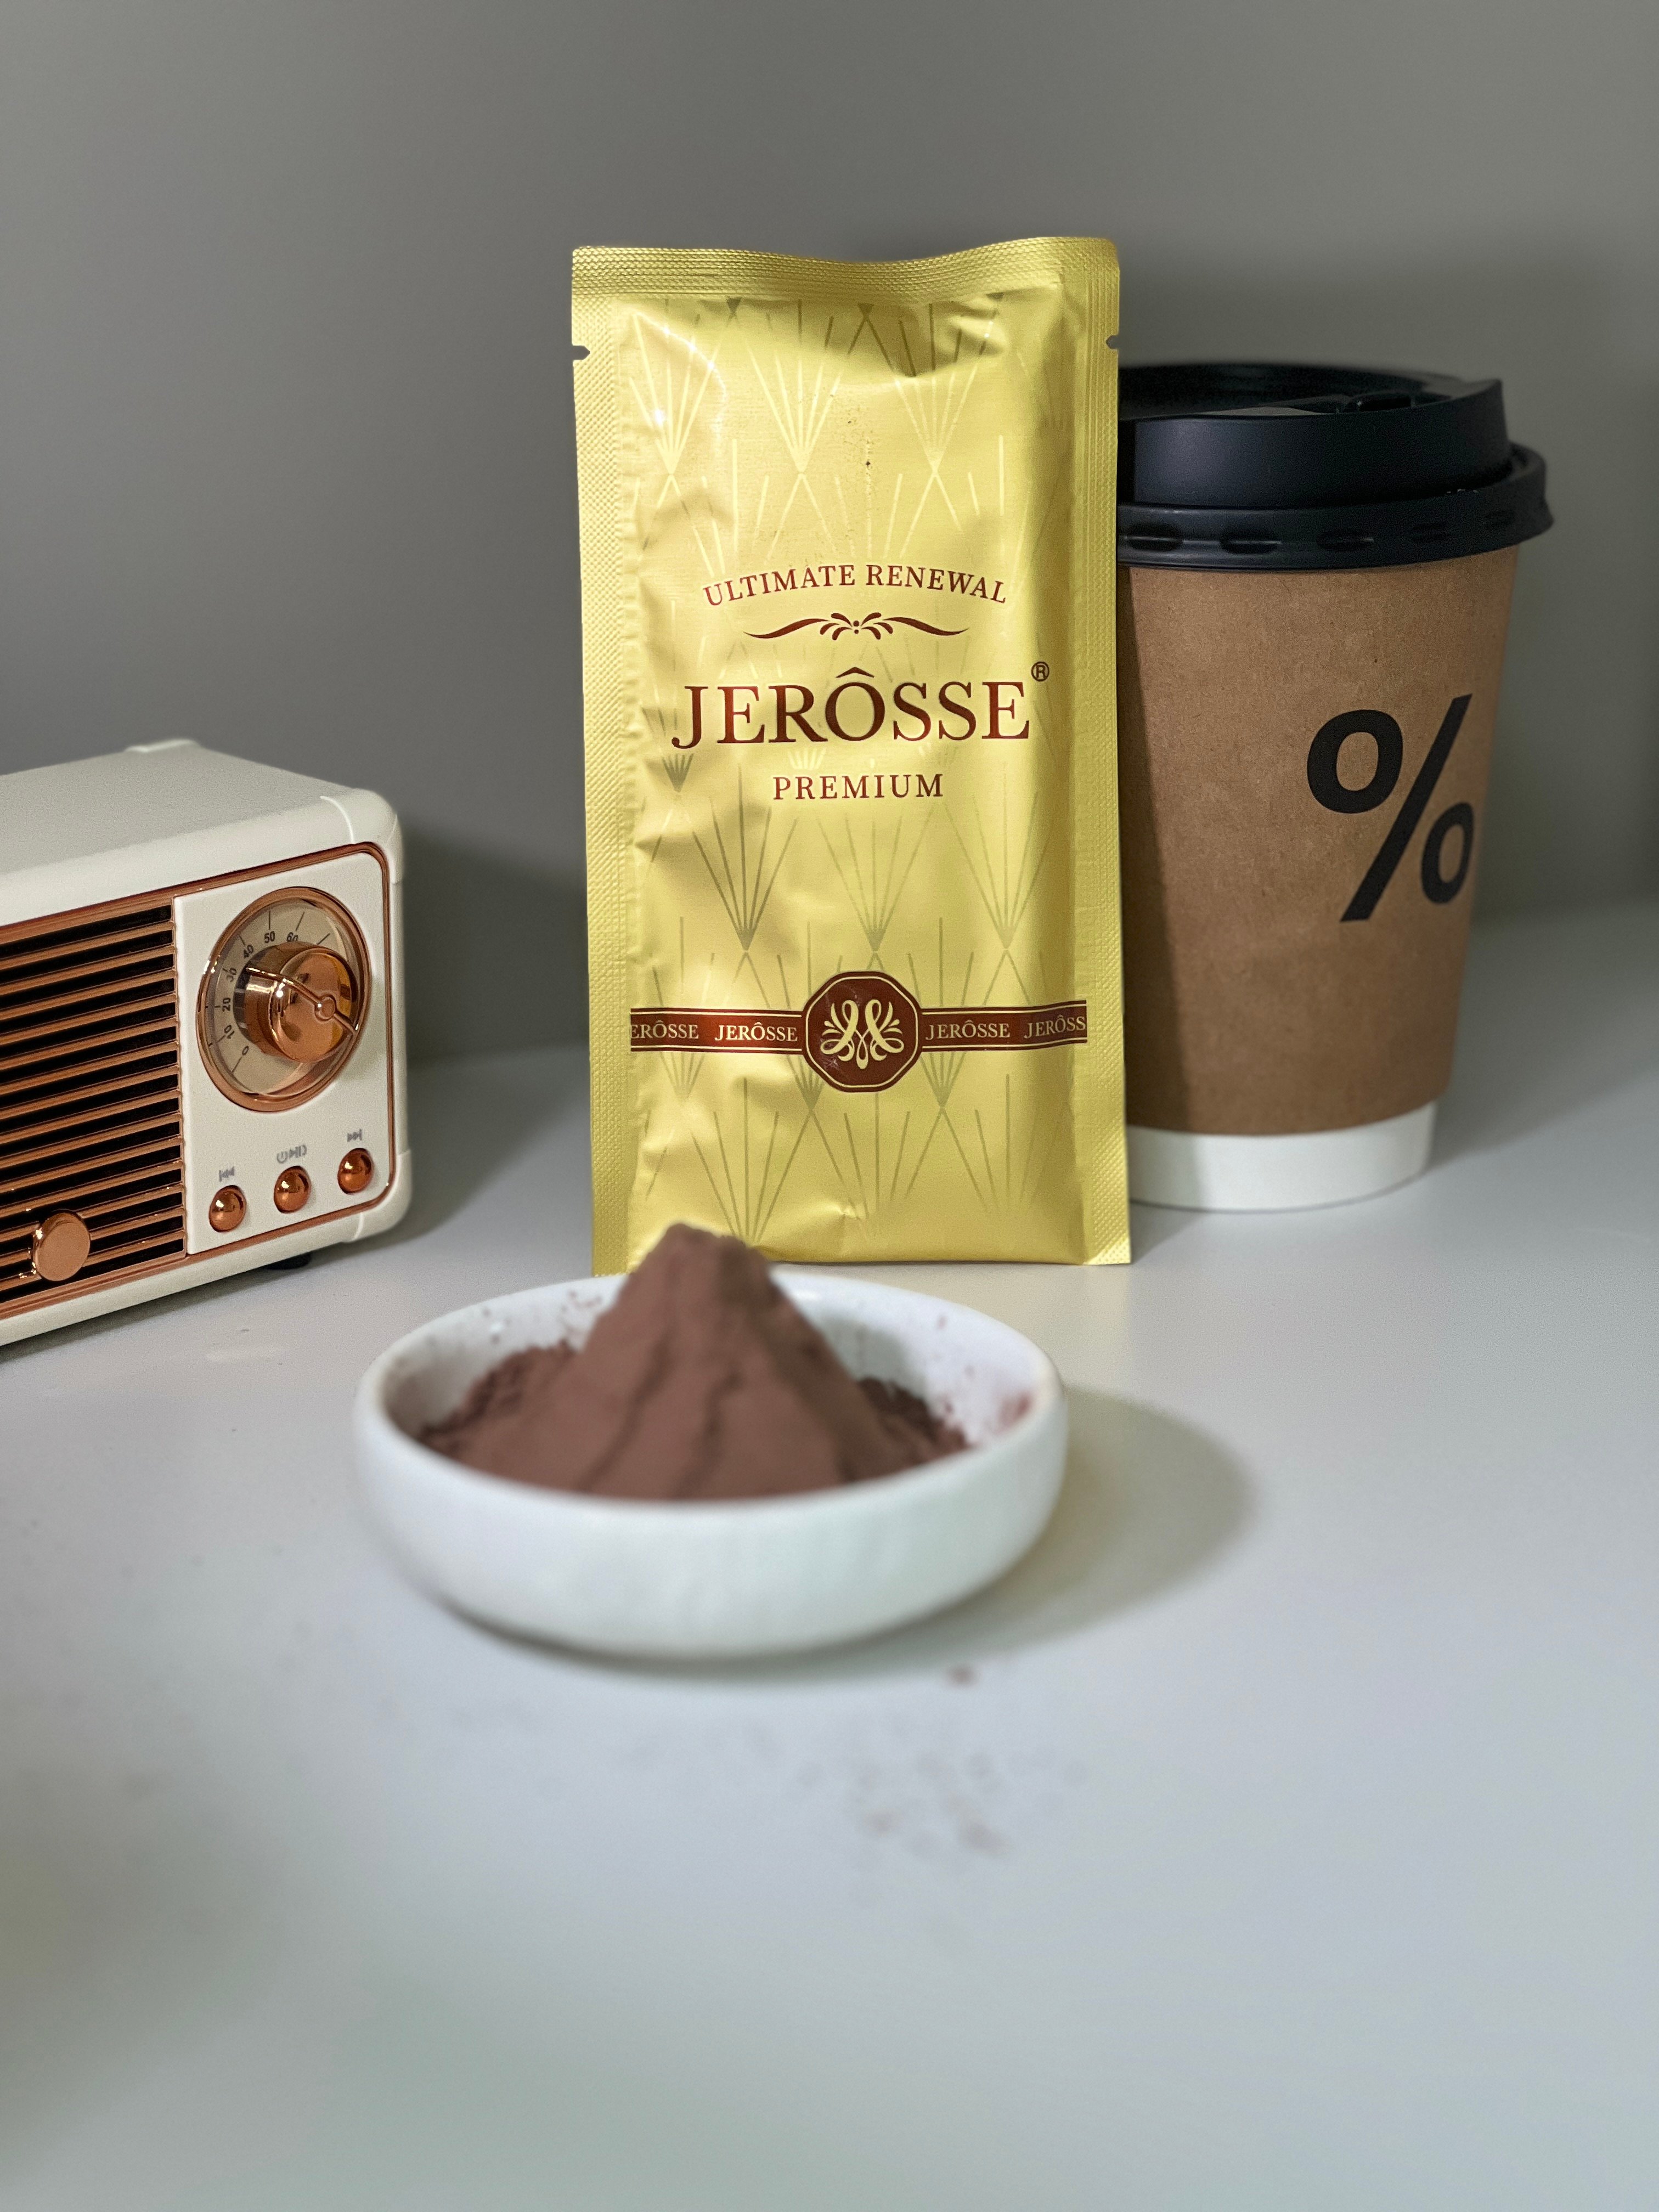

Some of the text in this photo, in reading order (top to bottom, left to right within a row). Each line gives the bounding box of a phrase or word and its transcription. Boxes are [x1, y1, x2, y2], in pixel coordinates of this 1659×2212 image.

[703, 564, 1007, 606] ULTIMATE RENEWAL
[772, 774, 944, 800] PREMIUM
[1306, 693, 1474, 923] %
[264, 930, 275, 944] 50
[242, 945, 254, 960] 40
[225, 967, 238, 983] 30
[222, 997, 232, 1013] 20
[223, 1024, 235, 1040] 10
[714, 1022, 798, 1042] JERÔSSE
[926, 1019, 1011, 1041] JERÔSSE
[241, 1045, 249, 1056] 0
